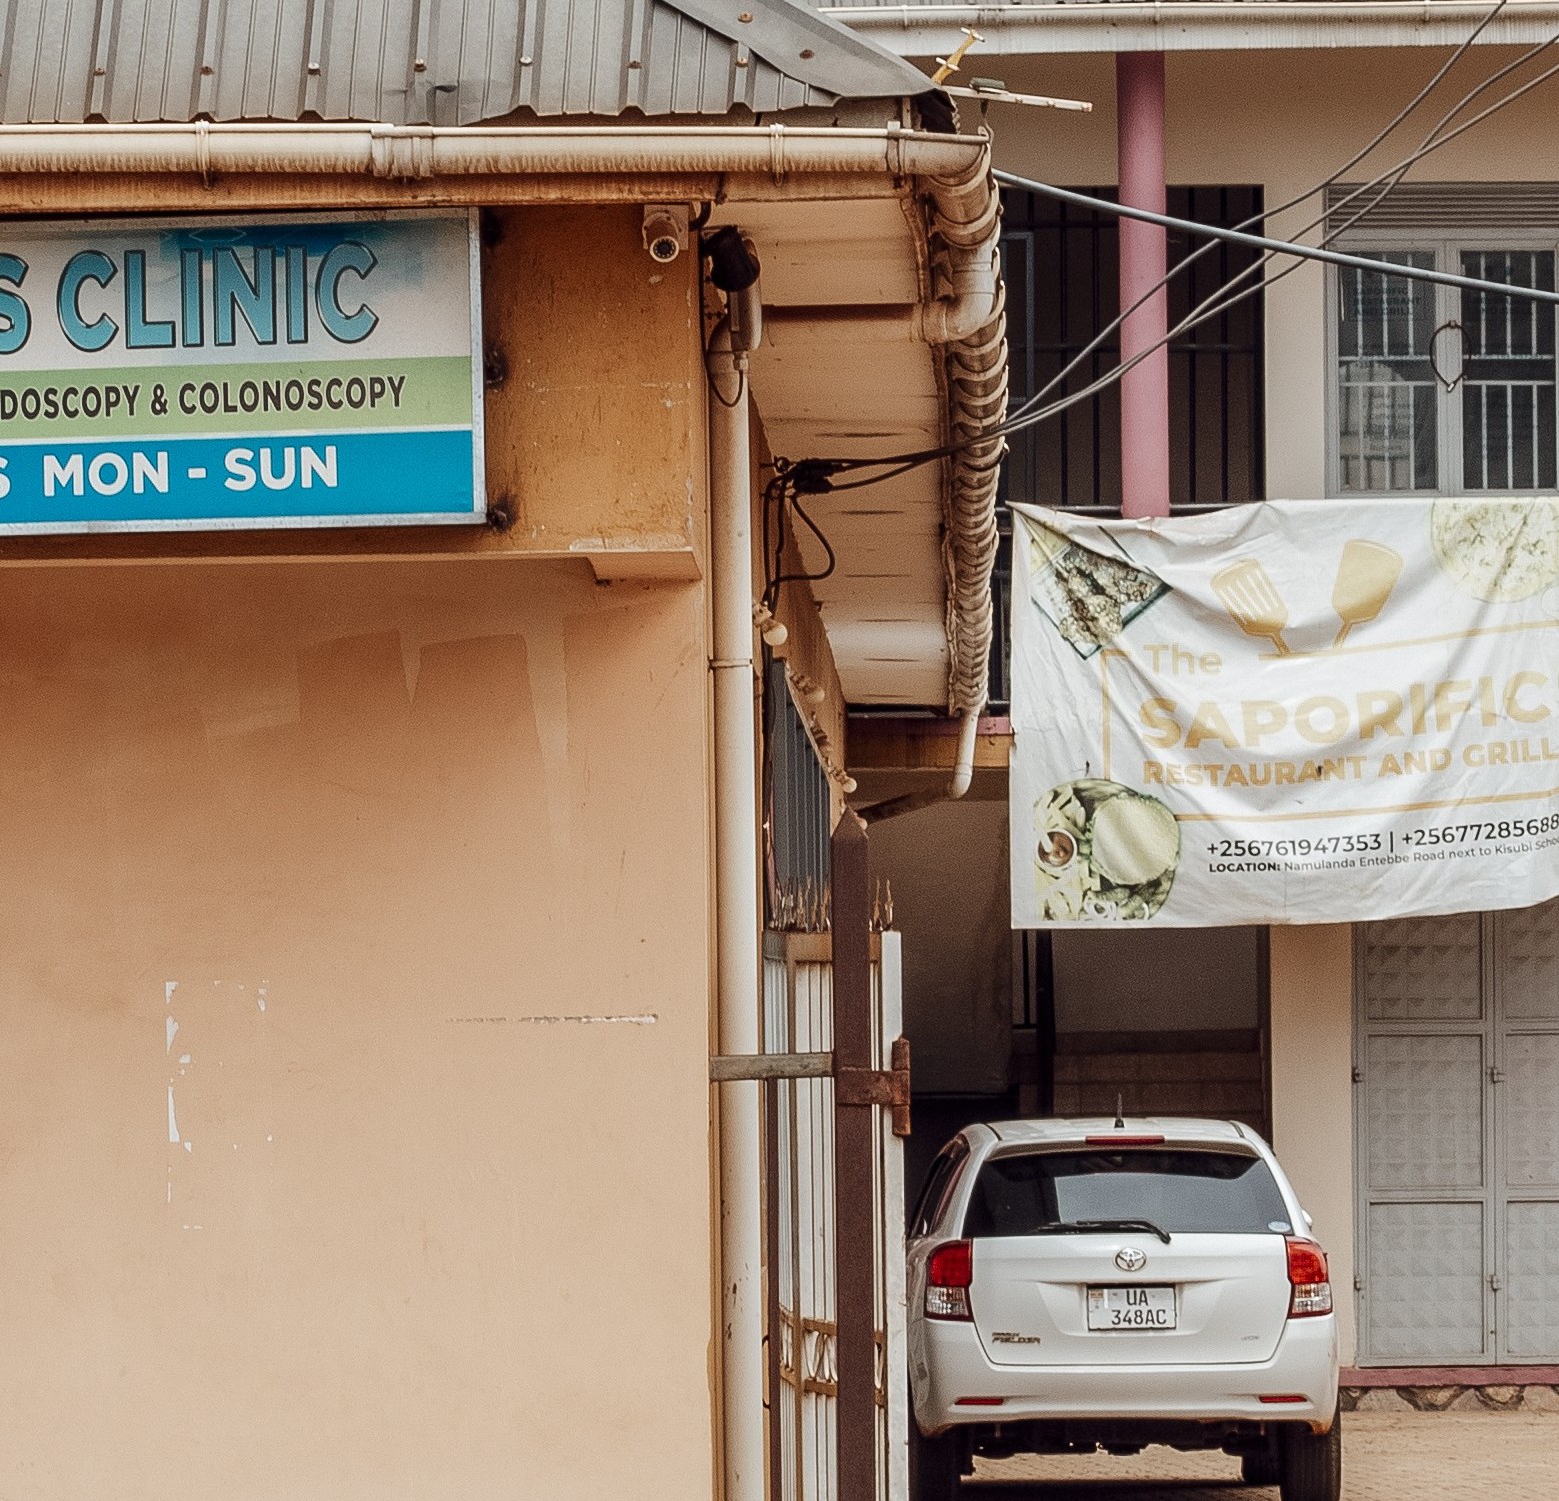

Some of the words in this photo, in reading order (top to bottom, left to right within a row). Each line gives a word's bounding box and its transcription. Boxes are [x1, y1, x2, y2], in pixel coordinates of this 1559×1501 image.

[55, 242, 380, 352] CLINIC
[149, 382, 169, 416] &
[178, 374, 407, 415] COLONOSCOPY
[42, 450, 171, 496] MON
[223, 445, 339, 491] SUN
[1144, 645, 1223, 676] The
[1140, 671, 1550, 750] SAPORIFIC
[1143, 754, 1368, 788] RESTAURANT
[1378, 746, 1451, 778] AND
[1463, 738, 1559, 767] GRILL
[1207, 832, 1382, 859] +256761947353
[1209, 861, 1281, 873] LOCATION:
[1284, 857, 1356, 872] Namulanda
[1360, 854, 1409, 867] Entebbe
[1414, 849, 1445, 863] Road
[1449, 846, 1476, 860] next
[1480, 844, 1492, 856] to
[1495, 839, 1532, 856] Kisubi
[1125, 1289, 1149, 1306] UA
[1111, 1309, 1167, 1325] 348AC
